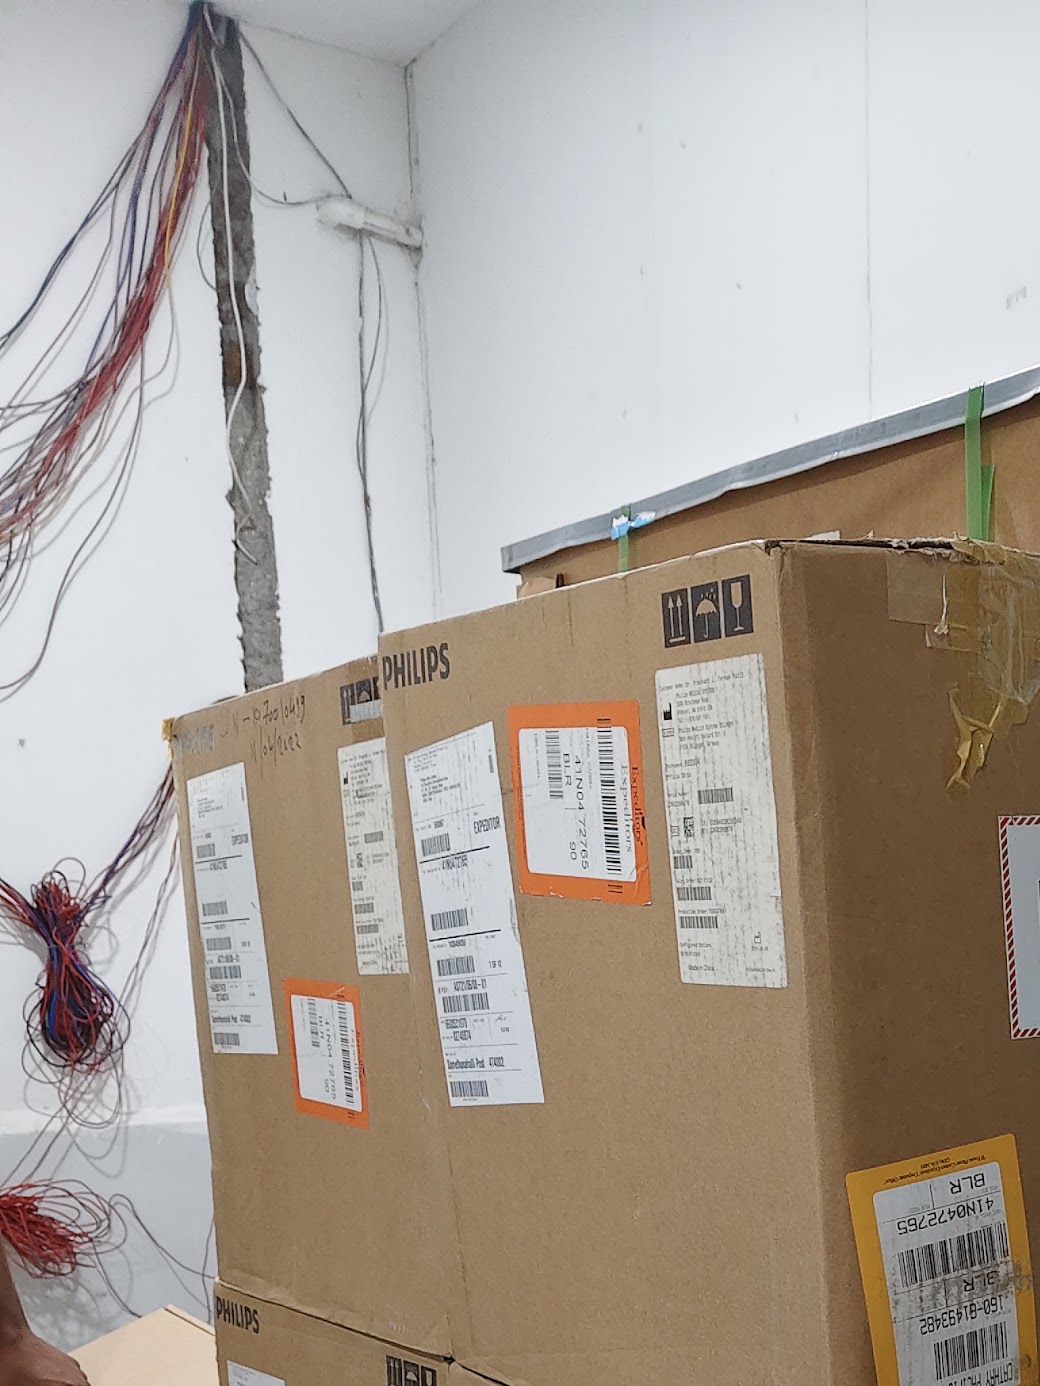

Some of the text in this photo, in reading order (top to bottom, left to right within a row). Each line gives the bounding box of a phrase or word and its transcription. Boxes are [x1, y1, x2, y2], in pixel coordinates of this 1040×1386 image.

[382, 642, 451, 691] PHILIPS
[562, 753, 572, 786] BLR
[950, 1172, 985, 1195] BLR
[896, 1197, 994, 1235] 41N0472765
[216, 1295, 260, 1335] PHILIPS
[919, 1295, 1004, 1335] 160-61493482
